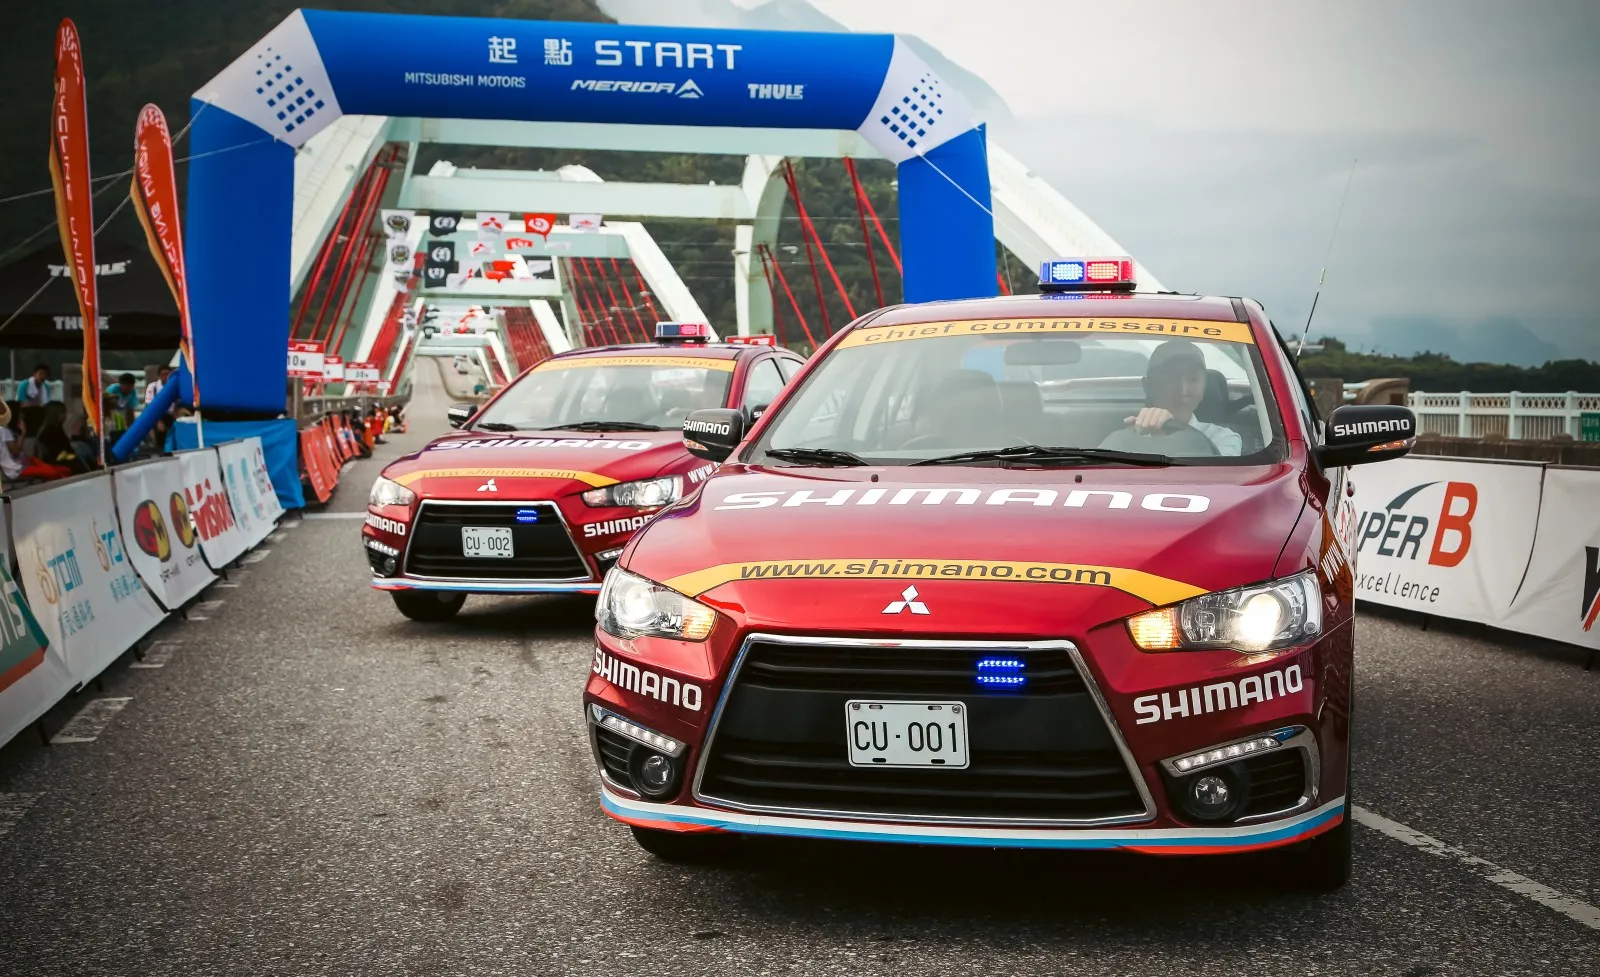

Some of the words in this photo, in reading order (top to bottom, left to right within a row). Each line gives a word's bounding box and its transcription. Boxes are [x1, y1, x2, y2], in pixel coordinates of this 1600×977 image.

[594, 40, 743, 71] START
[405, 72, 474, 86] MITSUBISHI
[478, 75, 526, 88] MOTORS
[571, 79, 676, 93] MERIDA
[747, 83, 804, 100] THULE
[53, 315, 110, 331] THE
[864, 321, 953, 343] chief
[970, 316, 1223, 337] commissaire
[682, 420, 730, 436] SHIMANO
[1333, 418, 1411, 438] SHIMANO
[430, 438, 653, 451] SHIMANO
[713, 487, 1212, 514] SHIMANO
[740, 559, 1113, 586] www.shimano.com
[593, 647, 703, 712] SHIMANO
[1133, 663, 1304, 725] SHIMANO
